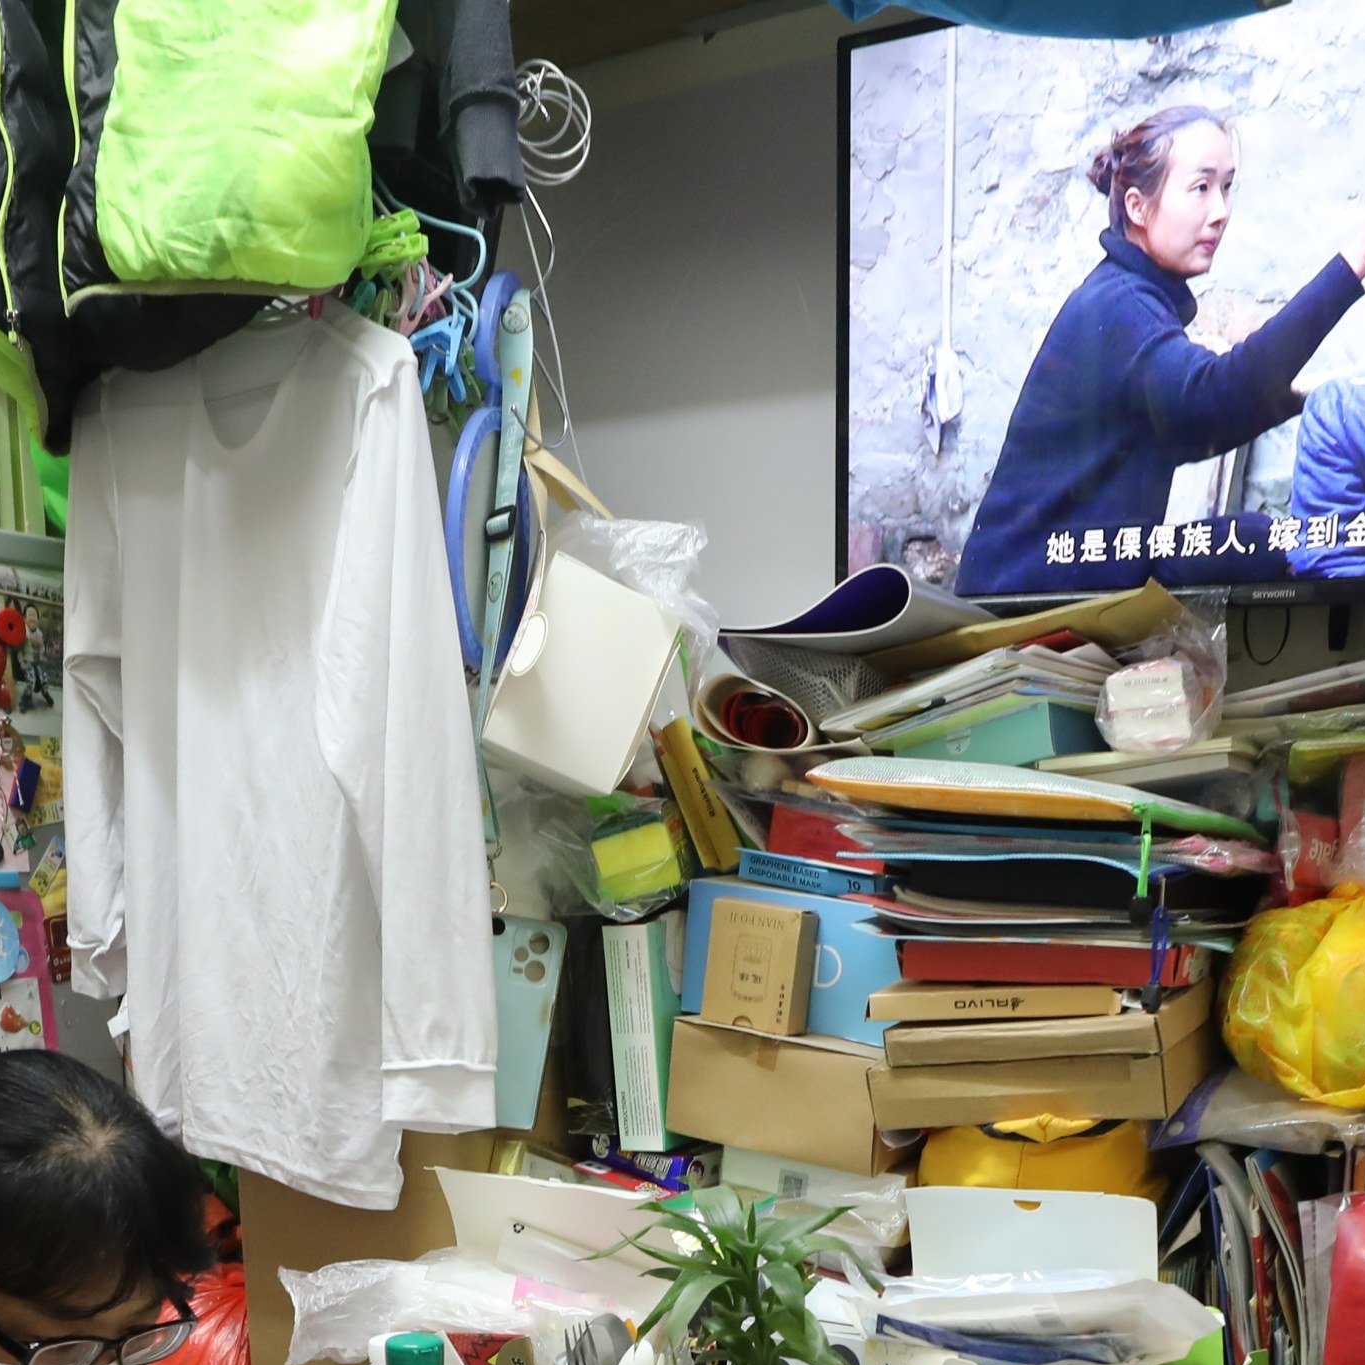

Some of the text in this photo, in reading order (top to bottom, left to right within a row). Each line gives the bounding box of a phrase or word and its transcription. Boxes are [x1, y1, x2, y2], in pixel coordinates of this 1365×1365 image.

[691, 766, 717, 818] Rilakkuma
[748, 867, 823, 891] DISPOSABLE MASK
[749, 855, 820, 879] GRAPHENE BASED
[847, 879, 862, 891] 10
